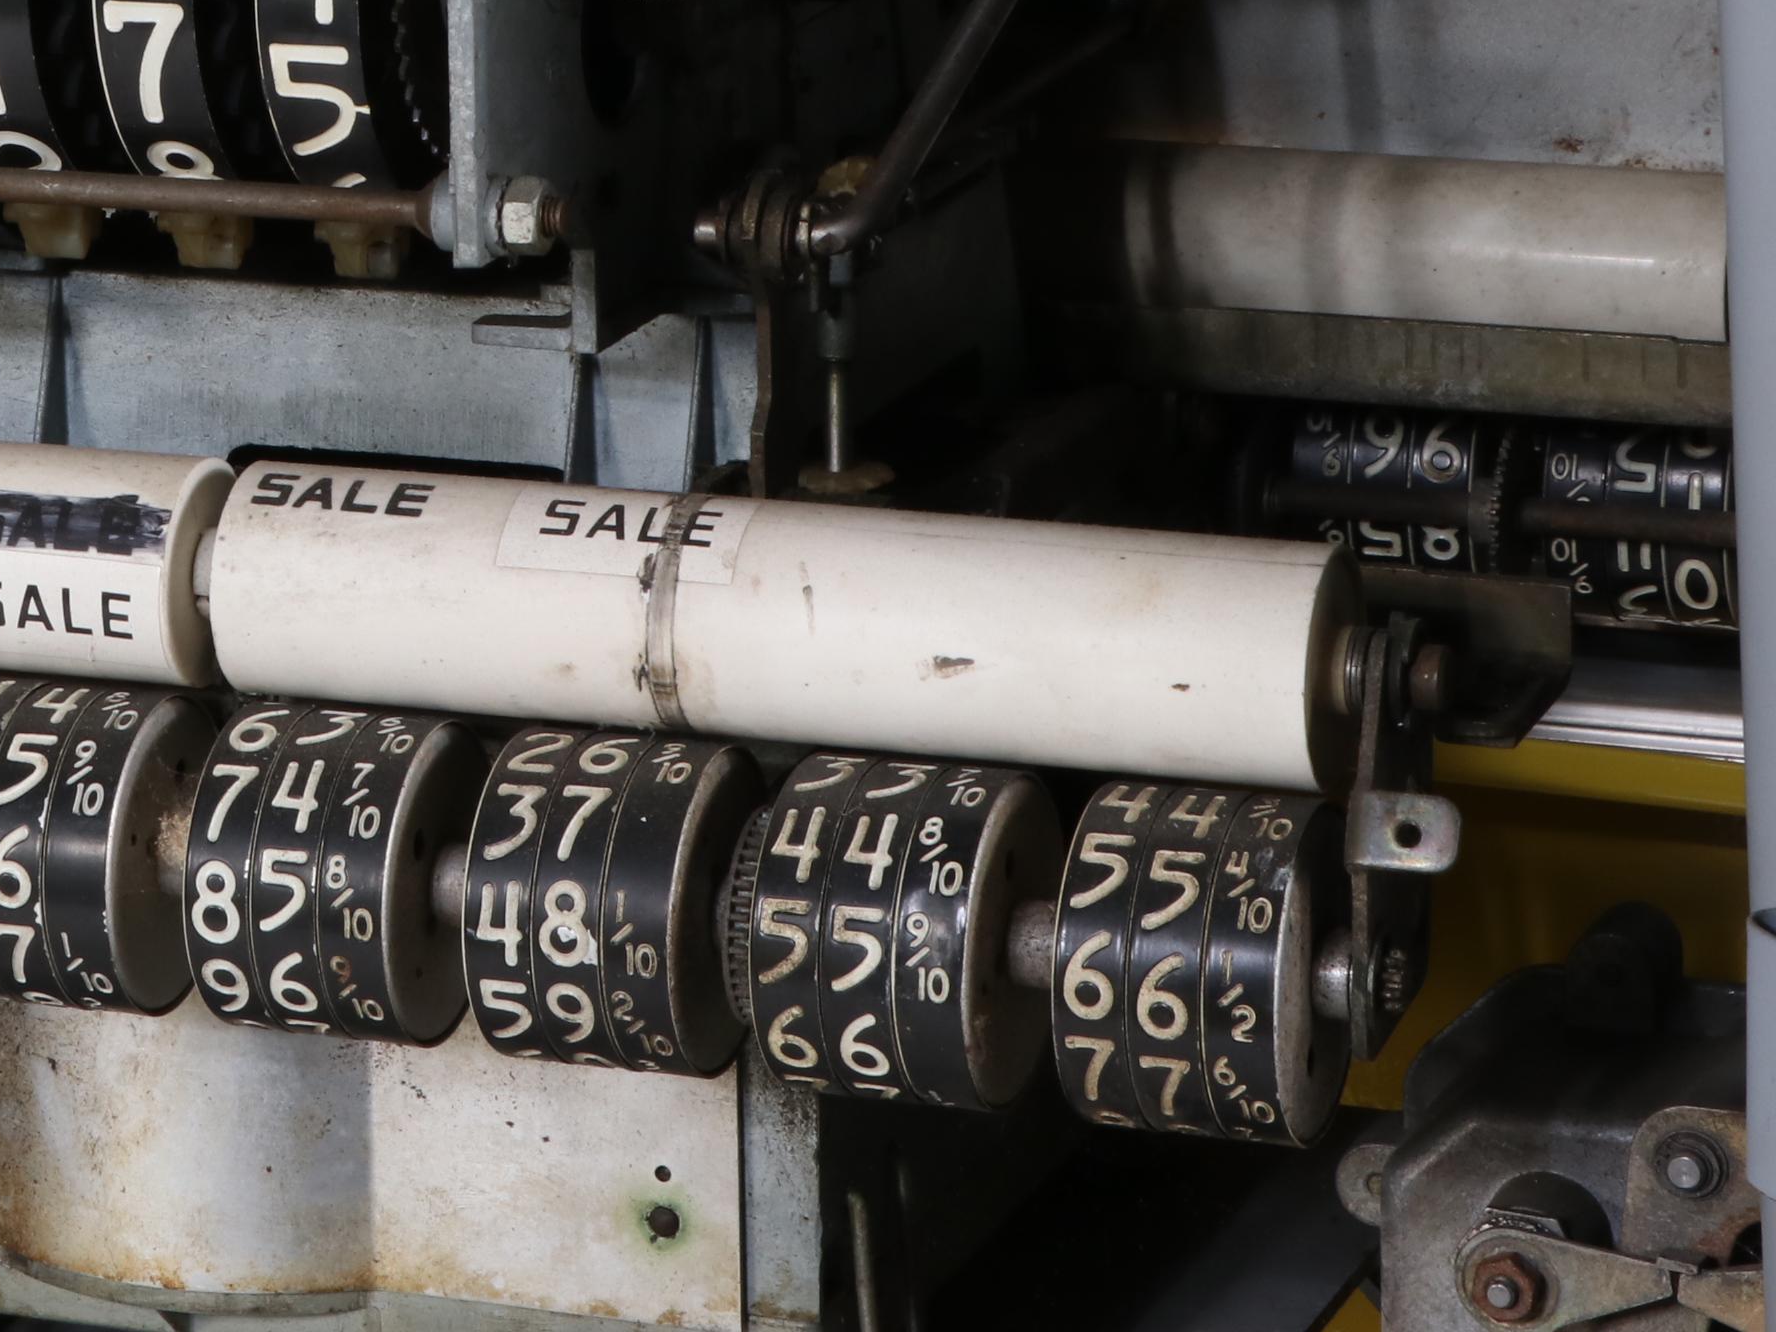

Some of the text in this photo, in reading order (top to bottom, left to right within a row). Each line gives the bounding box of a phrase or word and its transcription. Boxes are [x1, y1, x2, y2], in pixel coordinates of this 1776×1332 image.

[104, 0, 184, 124] 7
[269, 42, 356, 157] 5
[250, 472, 436, 518] SALE
[539, 500, 723, 547] SALE
